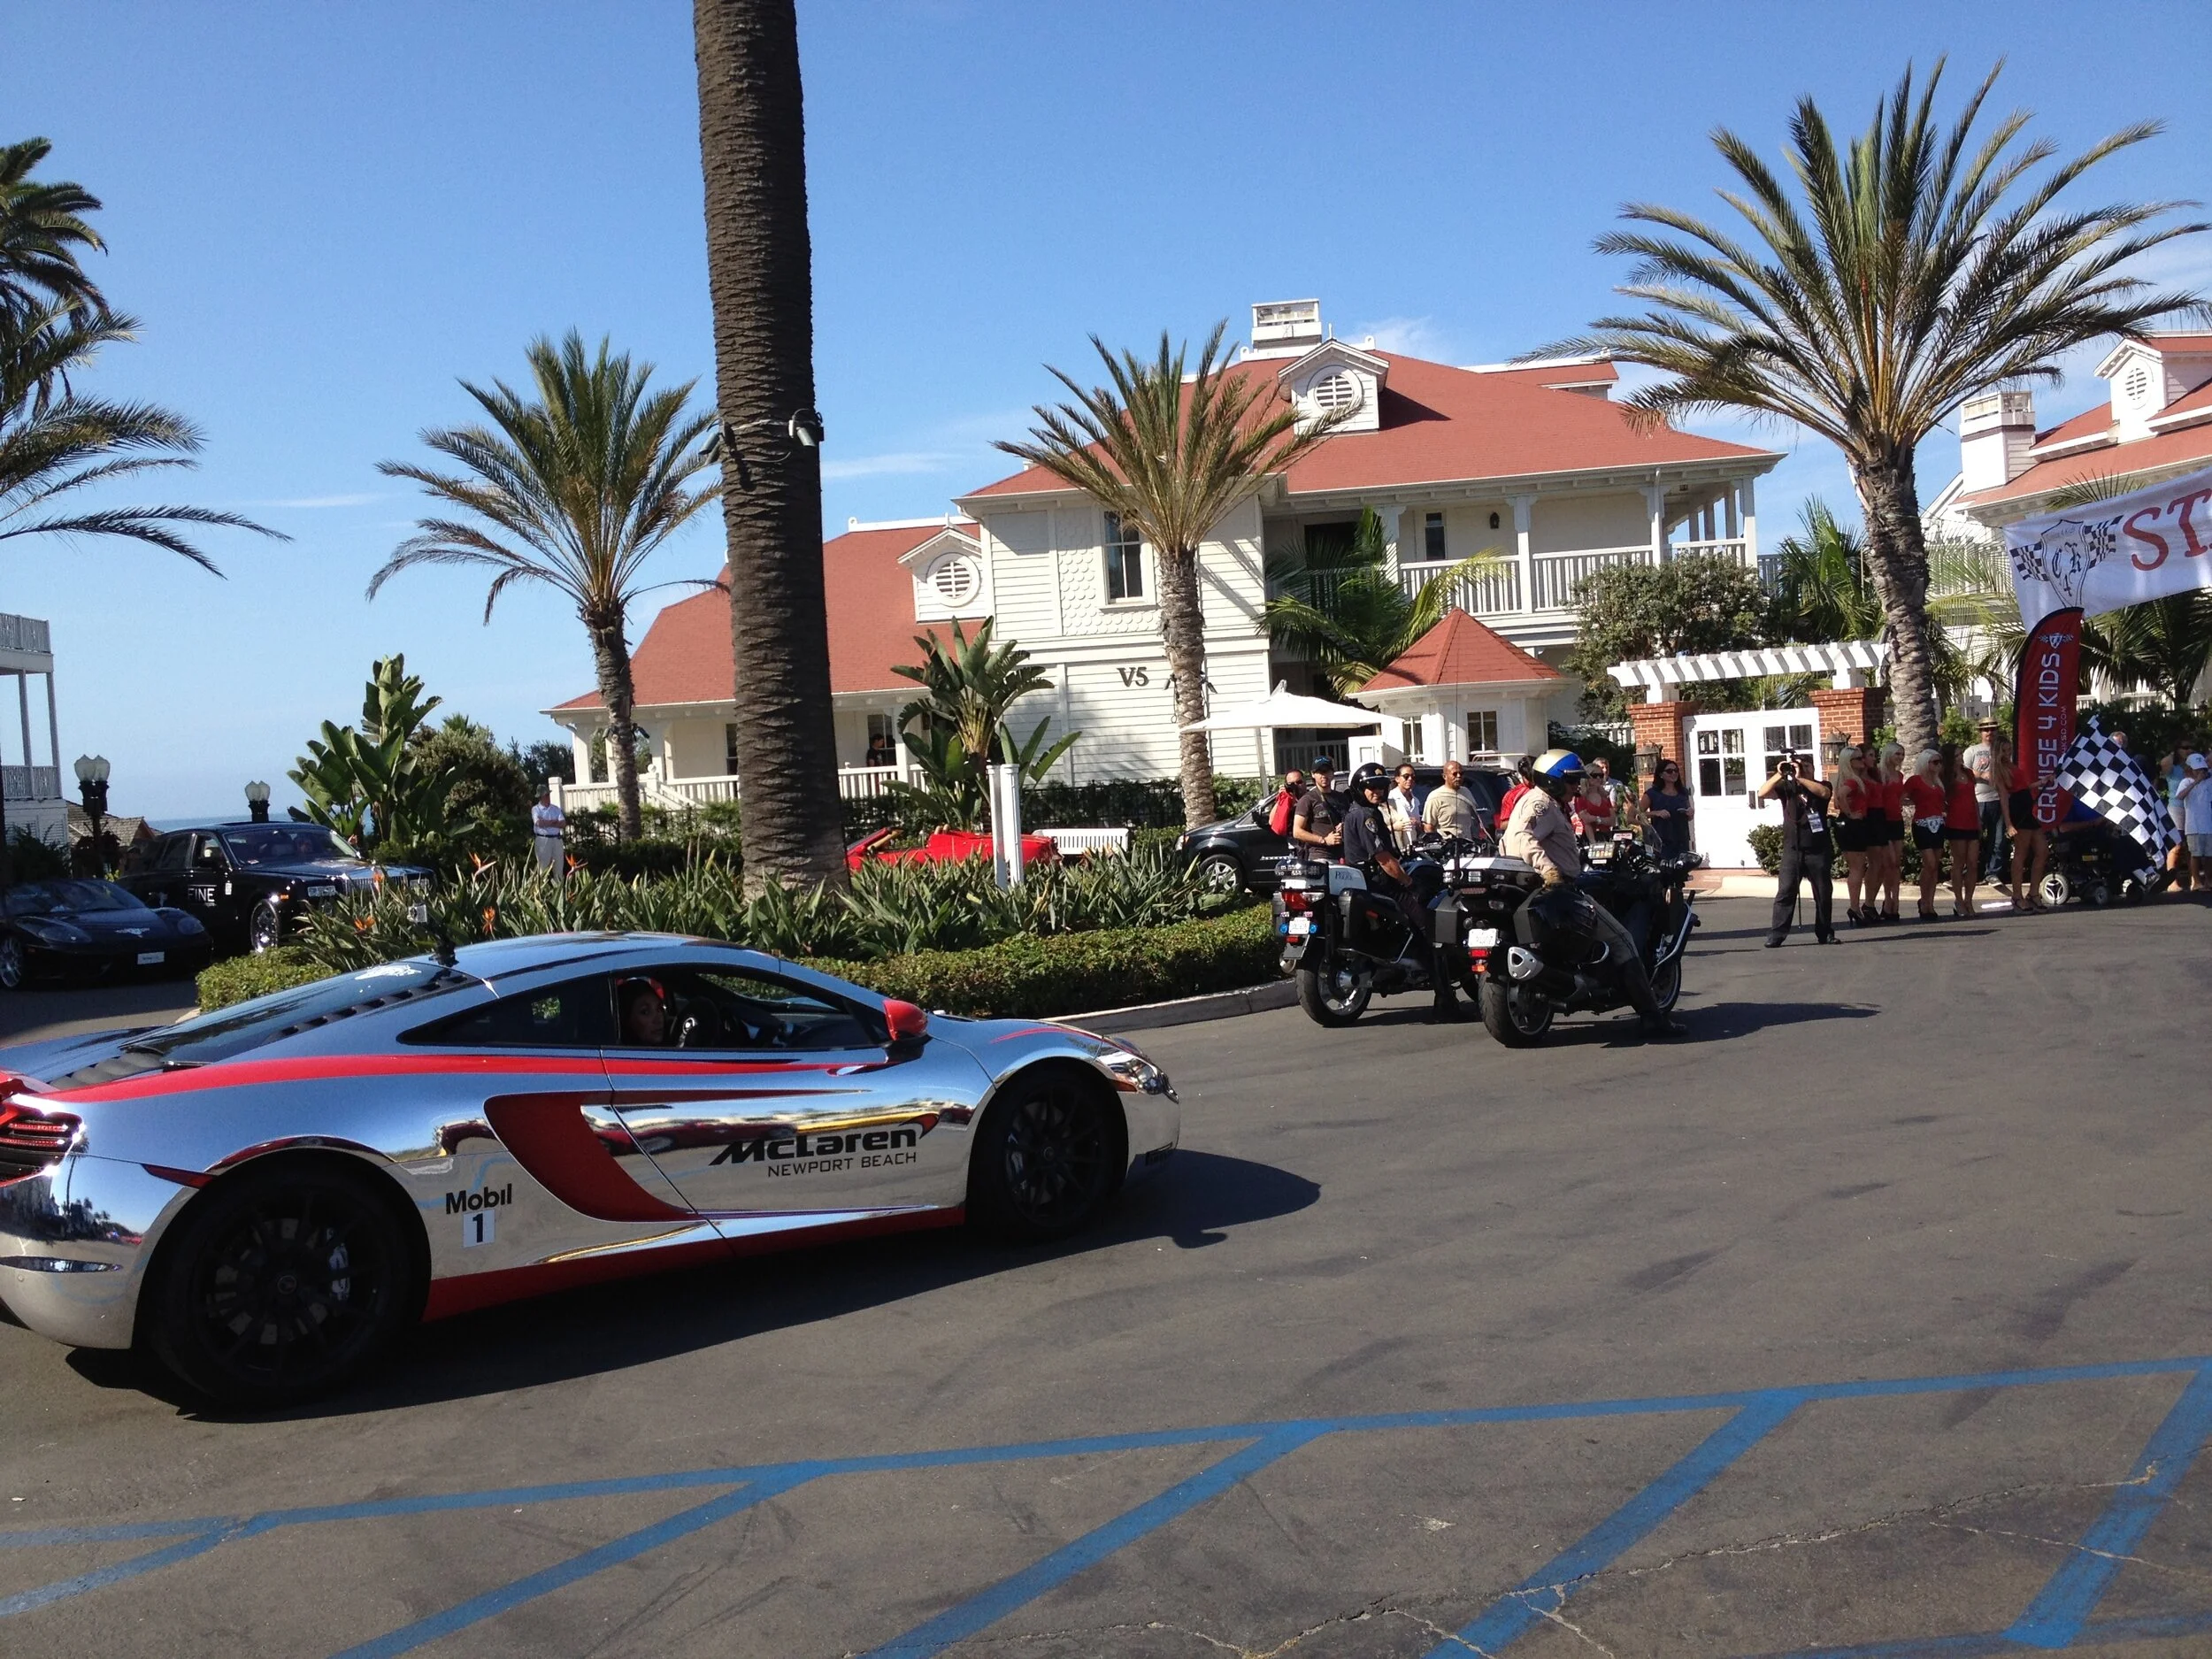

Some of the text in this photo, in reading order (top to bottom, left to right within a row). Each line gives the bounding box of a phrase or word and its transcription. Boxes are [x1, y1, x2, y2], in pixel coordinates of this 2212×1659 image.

[2124, 488, 2212, 571] ST
[1117, 666, 1149, 687] V5
[2038, 652, 2060, 824] CRUISE 4 KIDS
[188, 887, 216, 902] FINE
[709, 1128, 918, 1166] McLaren
[767, 1151, 918, 1178] NEWPORT BEACH
[445, 1183, 512, 1215] Mobil
[472, 1212, 484, 1243] 1
